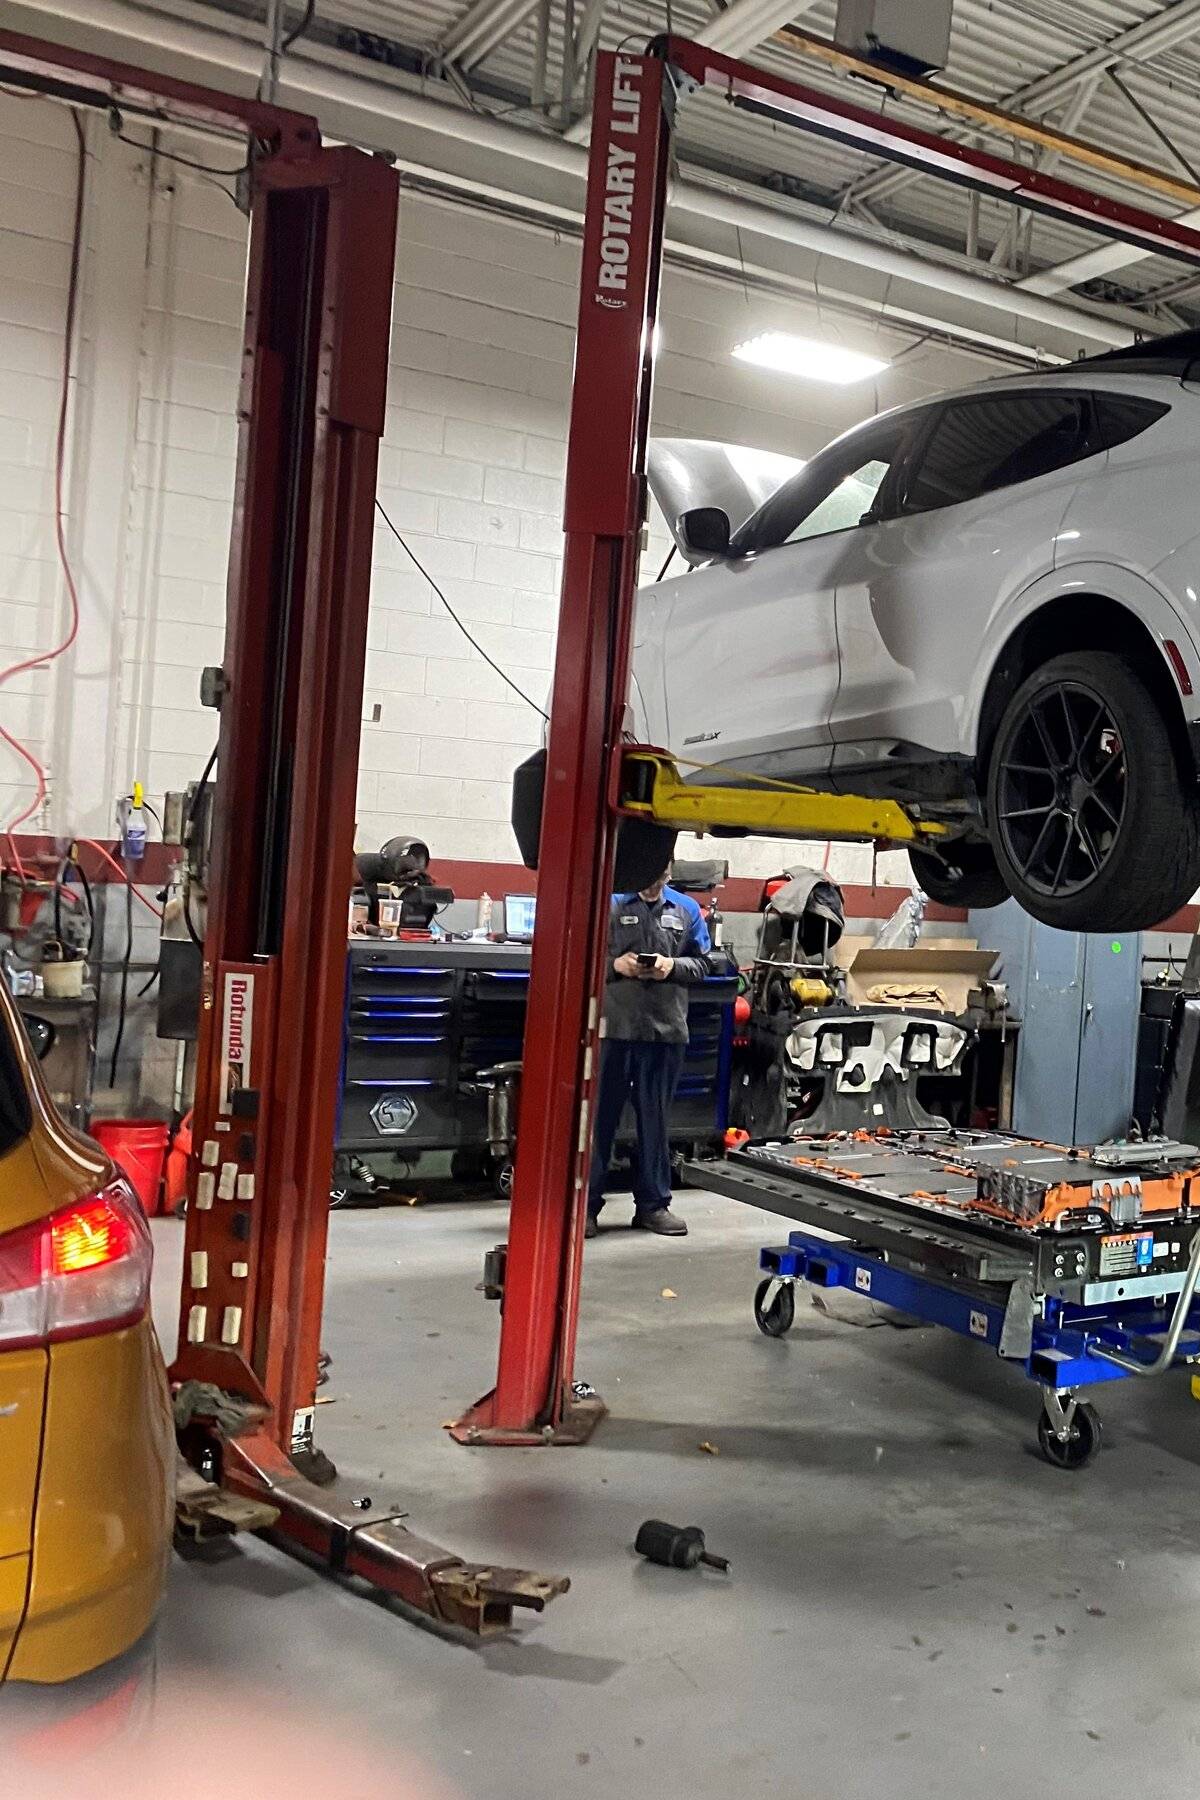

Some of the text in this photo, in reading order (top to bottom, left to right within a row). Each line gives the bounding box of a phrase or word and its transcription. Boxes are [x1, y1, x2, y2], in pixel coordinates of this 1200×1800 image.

[598, 56, 643, 289] ROTARY LIFT
[228, 979, 248, 1060] Rotunda
